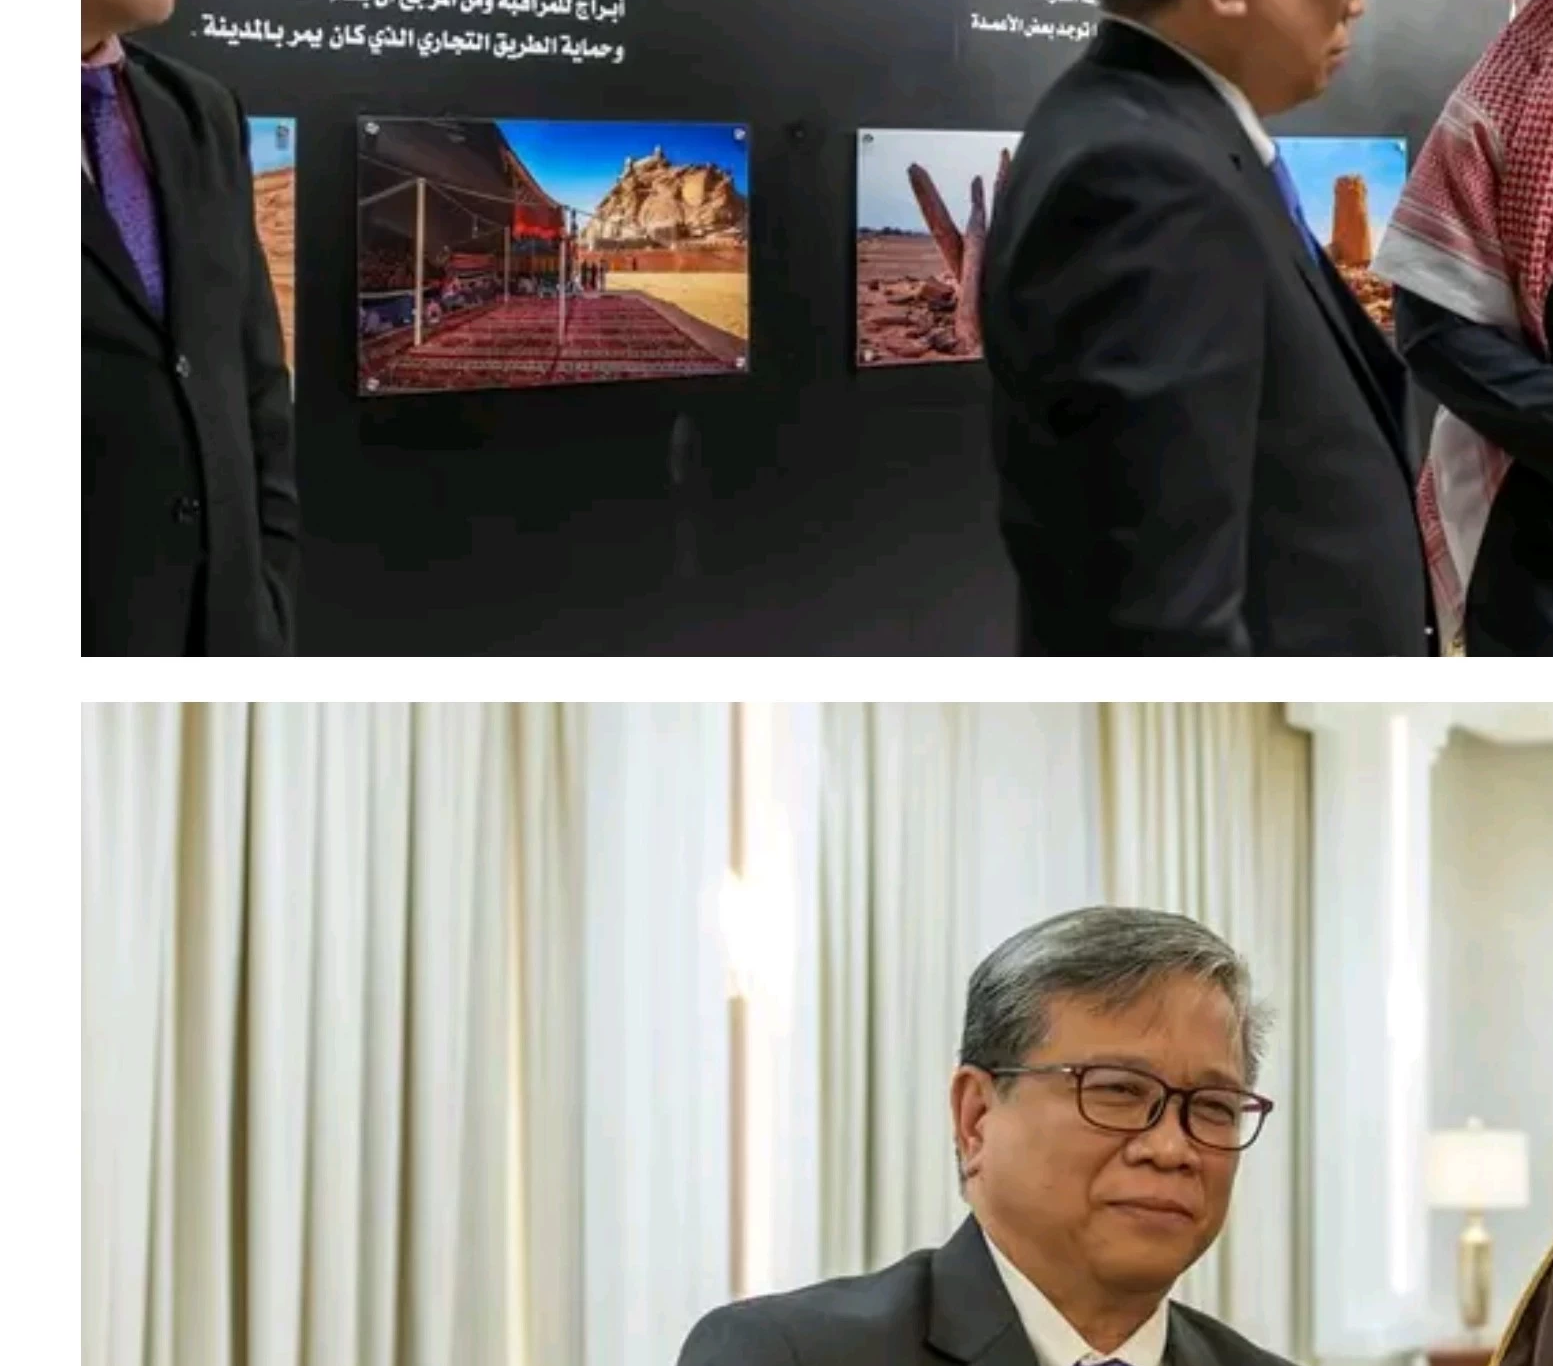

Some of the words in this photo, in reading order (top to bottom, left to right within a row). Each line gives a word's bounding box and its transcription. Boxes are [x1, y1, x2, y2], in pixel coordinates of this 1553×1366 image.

[201, 12, 285, 48] بالمدينة
[286, 26, 323, 48] يمر
[328, 24, 367, 50] كان
[367, 26, 415, 55] الذي
[416, 29, 491, 58] التجاري
[492, 32, 558, 61] الطريق
[559, 35, 625, 64] وحماية
